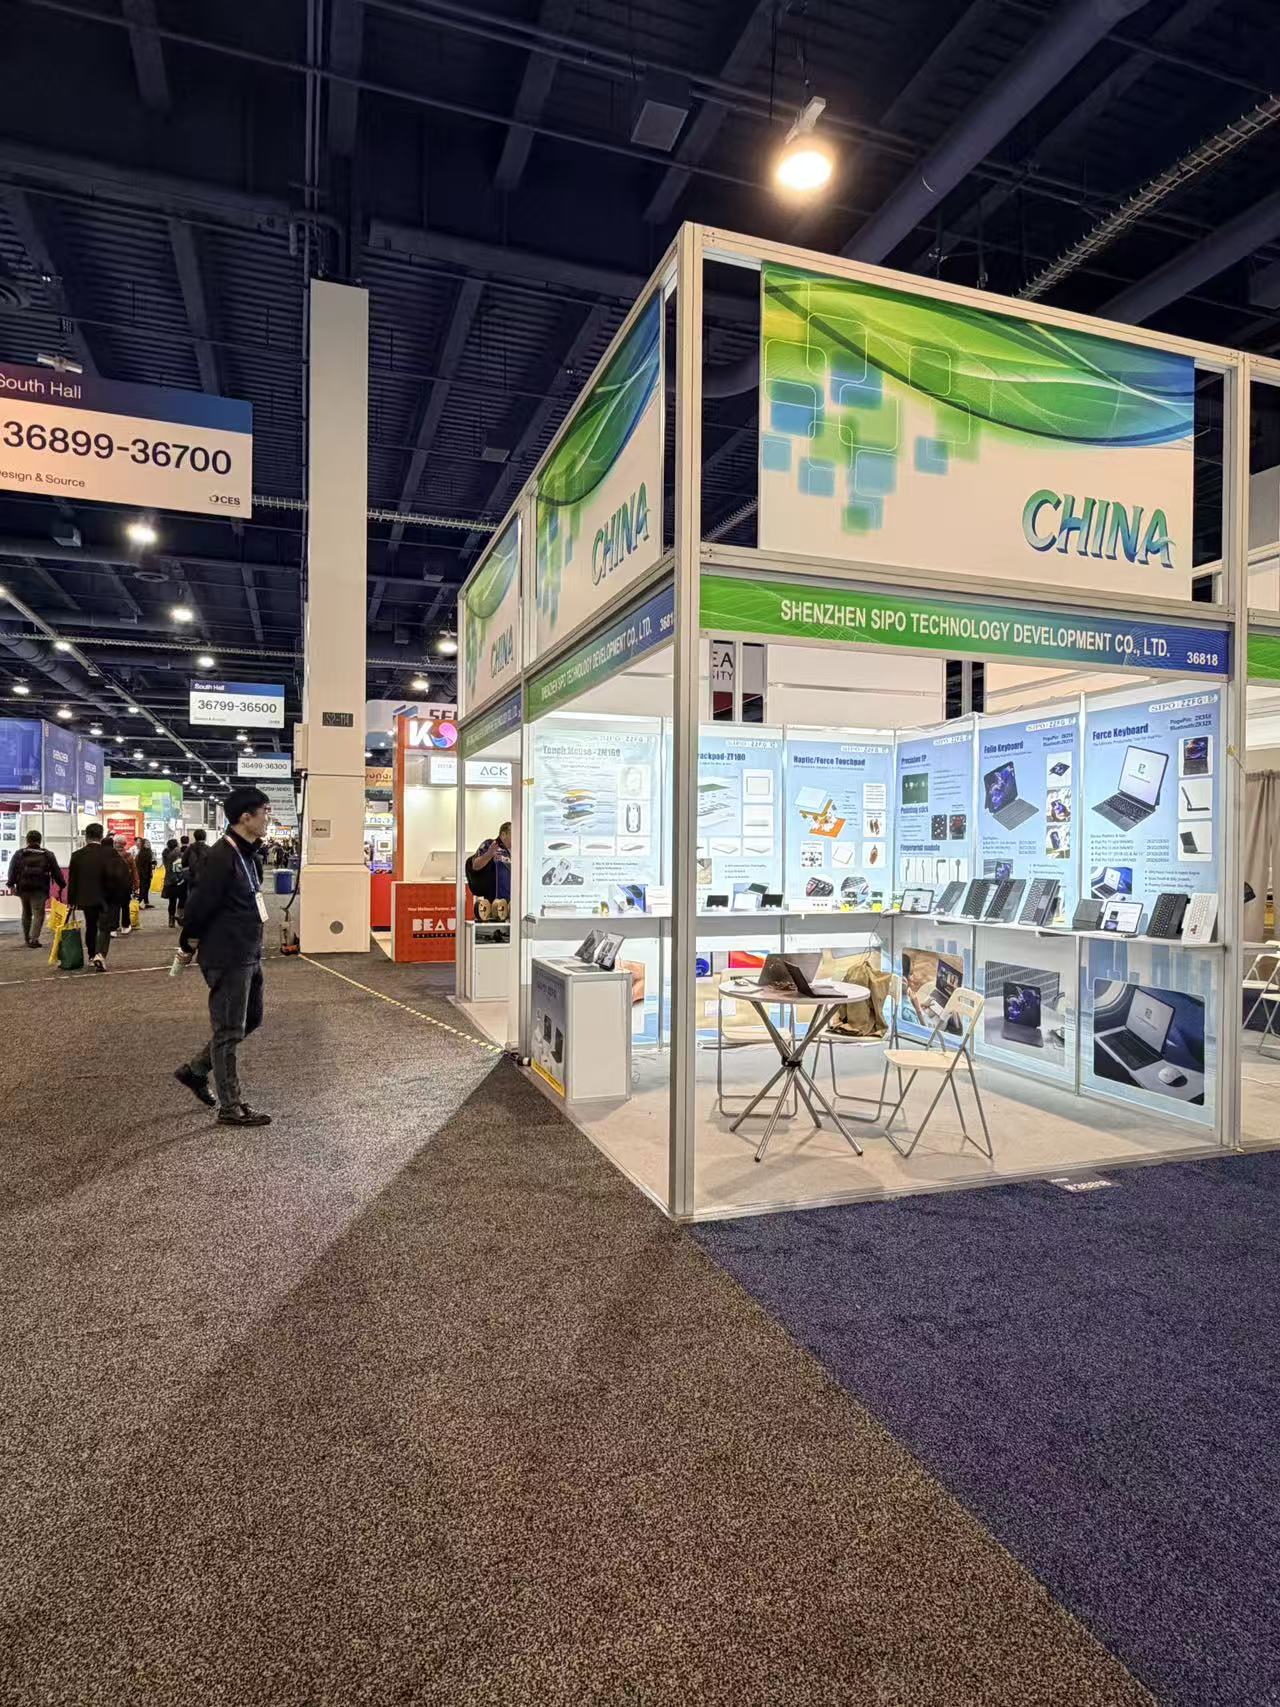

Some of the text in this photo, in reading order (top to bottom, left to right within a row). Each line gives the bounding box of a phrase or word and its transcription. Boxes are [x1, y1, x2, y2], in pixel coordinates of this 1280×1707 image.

[50, 381, 82, 399] Hall
[3, 421, 232, 475] 36899-36700
[0, 470, 86, 487] esign & Source
[220, 496, 241, 505] CES
[591, 482, 650, 586] CHINA
[1022, 489, 1176, 569] CHINA
[780, 600, 866, 628] SHENZHEN
[870, 608, 907, 632] SIPO
[911, 613, 1011, 641] TECHNOLOGY
[1013, 623, 1112, 652] DEVELOPMENT
[1143, 637, 1170, 657] LTD.
[1186, 651, 1219, 666] 36818
[198, 699, 277, 714] 36799-36500
[1093, 730, 1112, 741] Force
[1113, 723, 1149, 739] Keyboard
